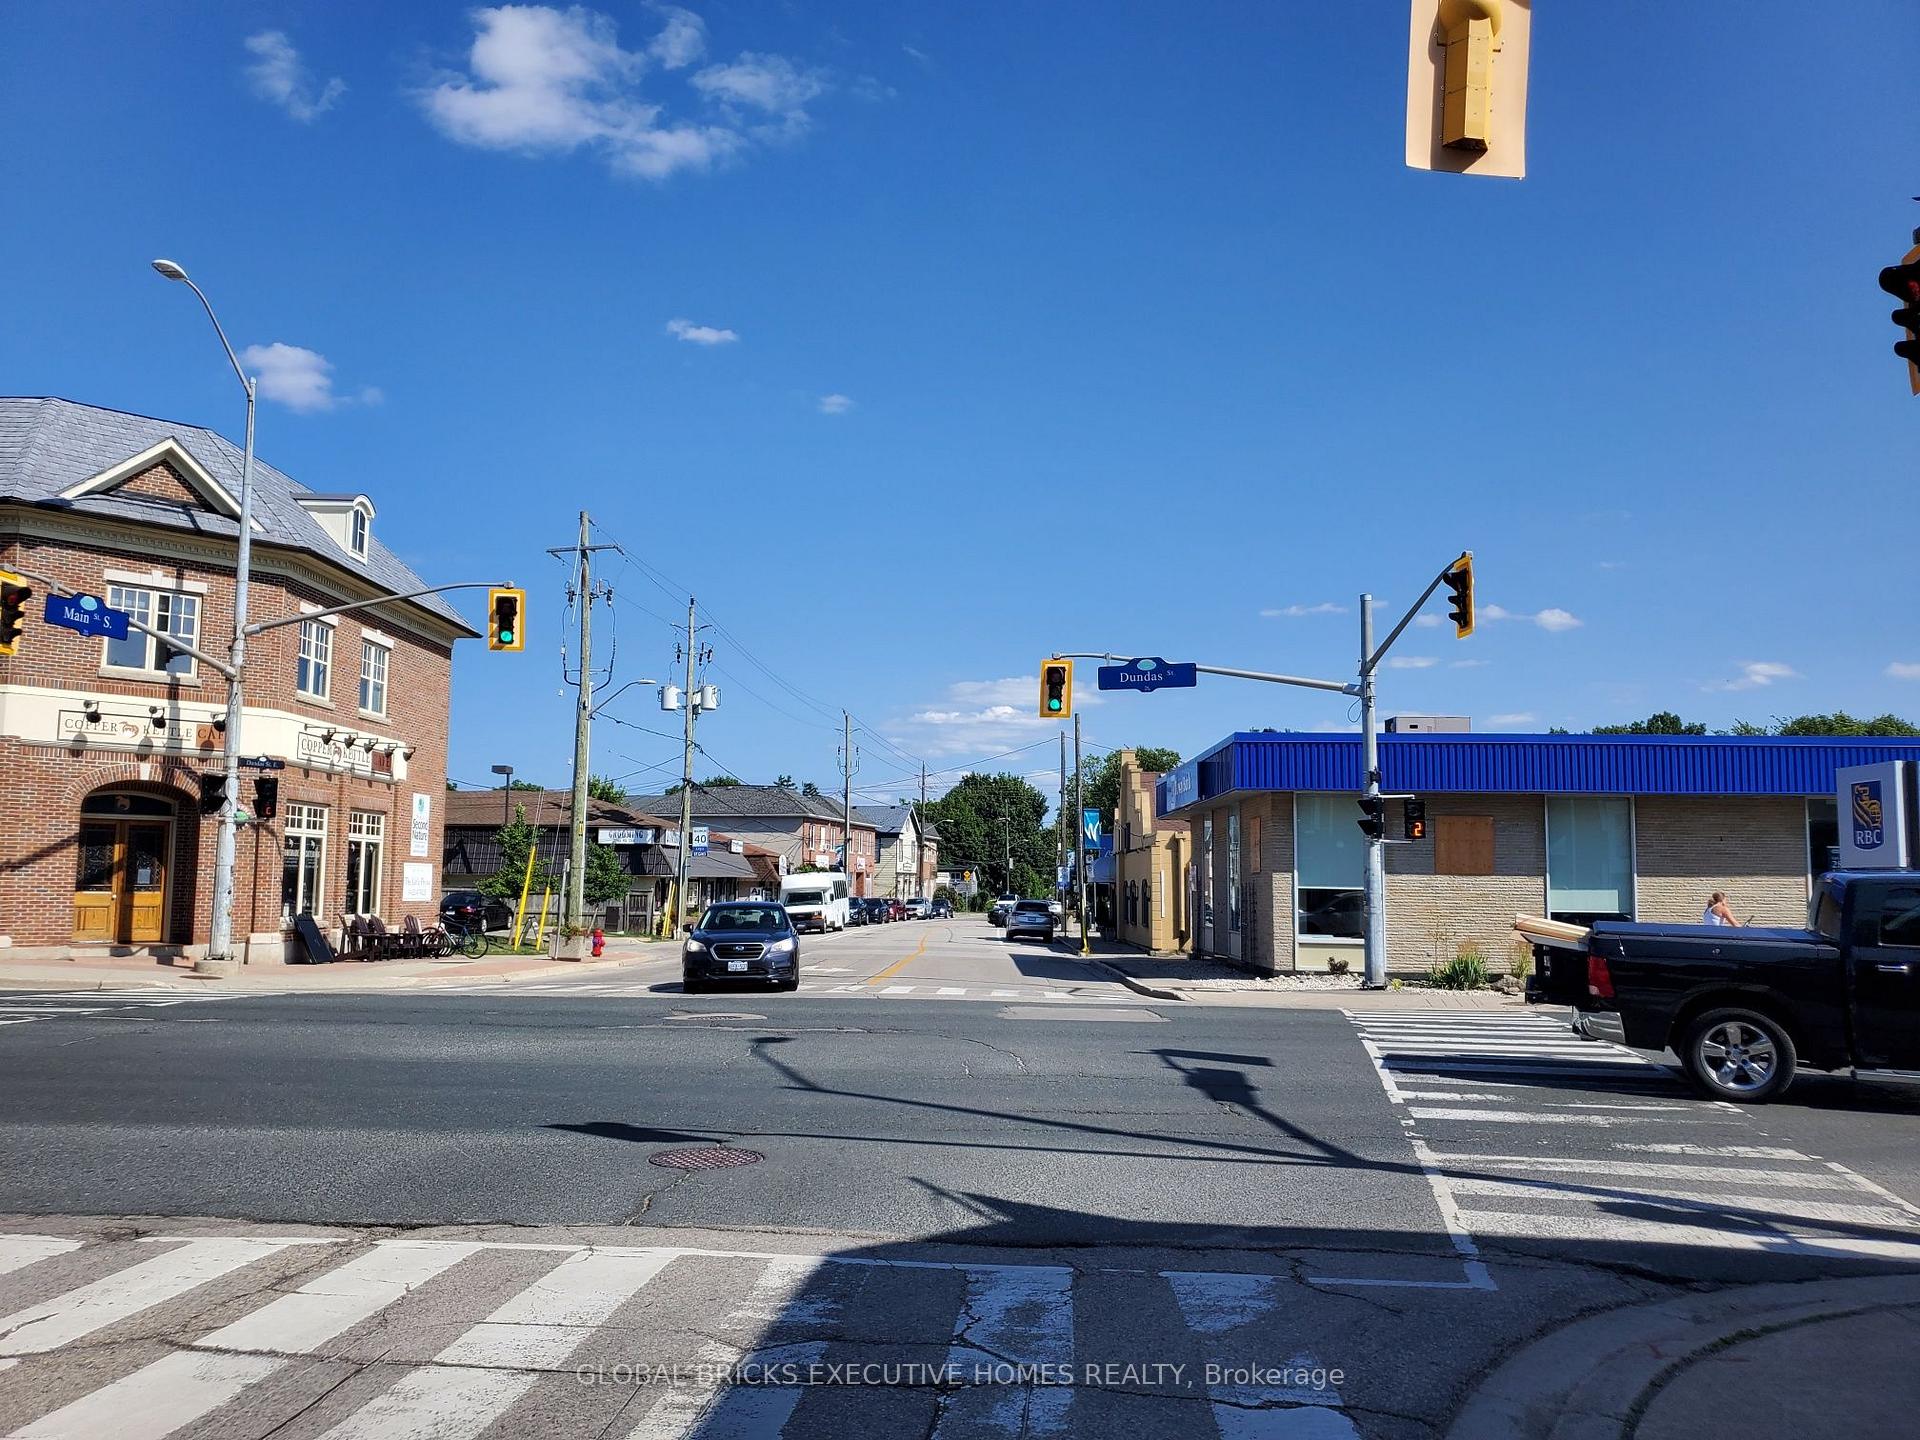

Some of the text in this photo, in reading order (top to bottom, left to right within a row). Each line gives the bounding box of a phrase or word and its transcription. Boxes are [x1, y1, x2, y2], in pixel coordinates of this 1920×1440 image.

[63, 606, 90, 624] Main
[103, 615, 112, 629] S.
[1120, 672, 1163, 682] Dundas
[64, 718, 225, 740] COPPER KETTLE CAF
[301, 737, 333, 756] COPPER
[342, 747, 371, 764] KETTLE
[1415, 822, 1421, 836] 2
[1856, 829, 1881, 845] RBC
[694, 834, 707, 844] 40
